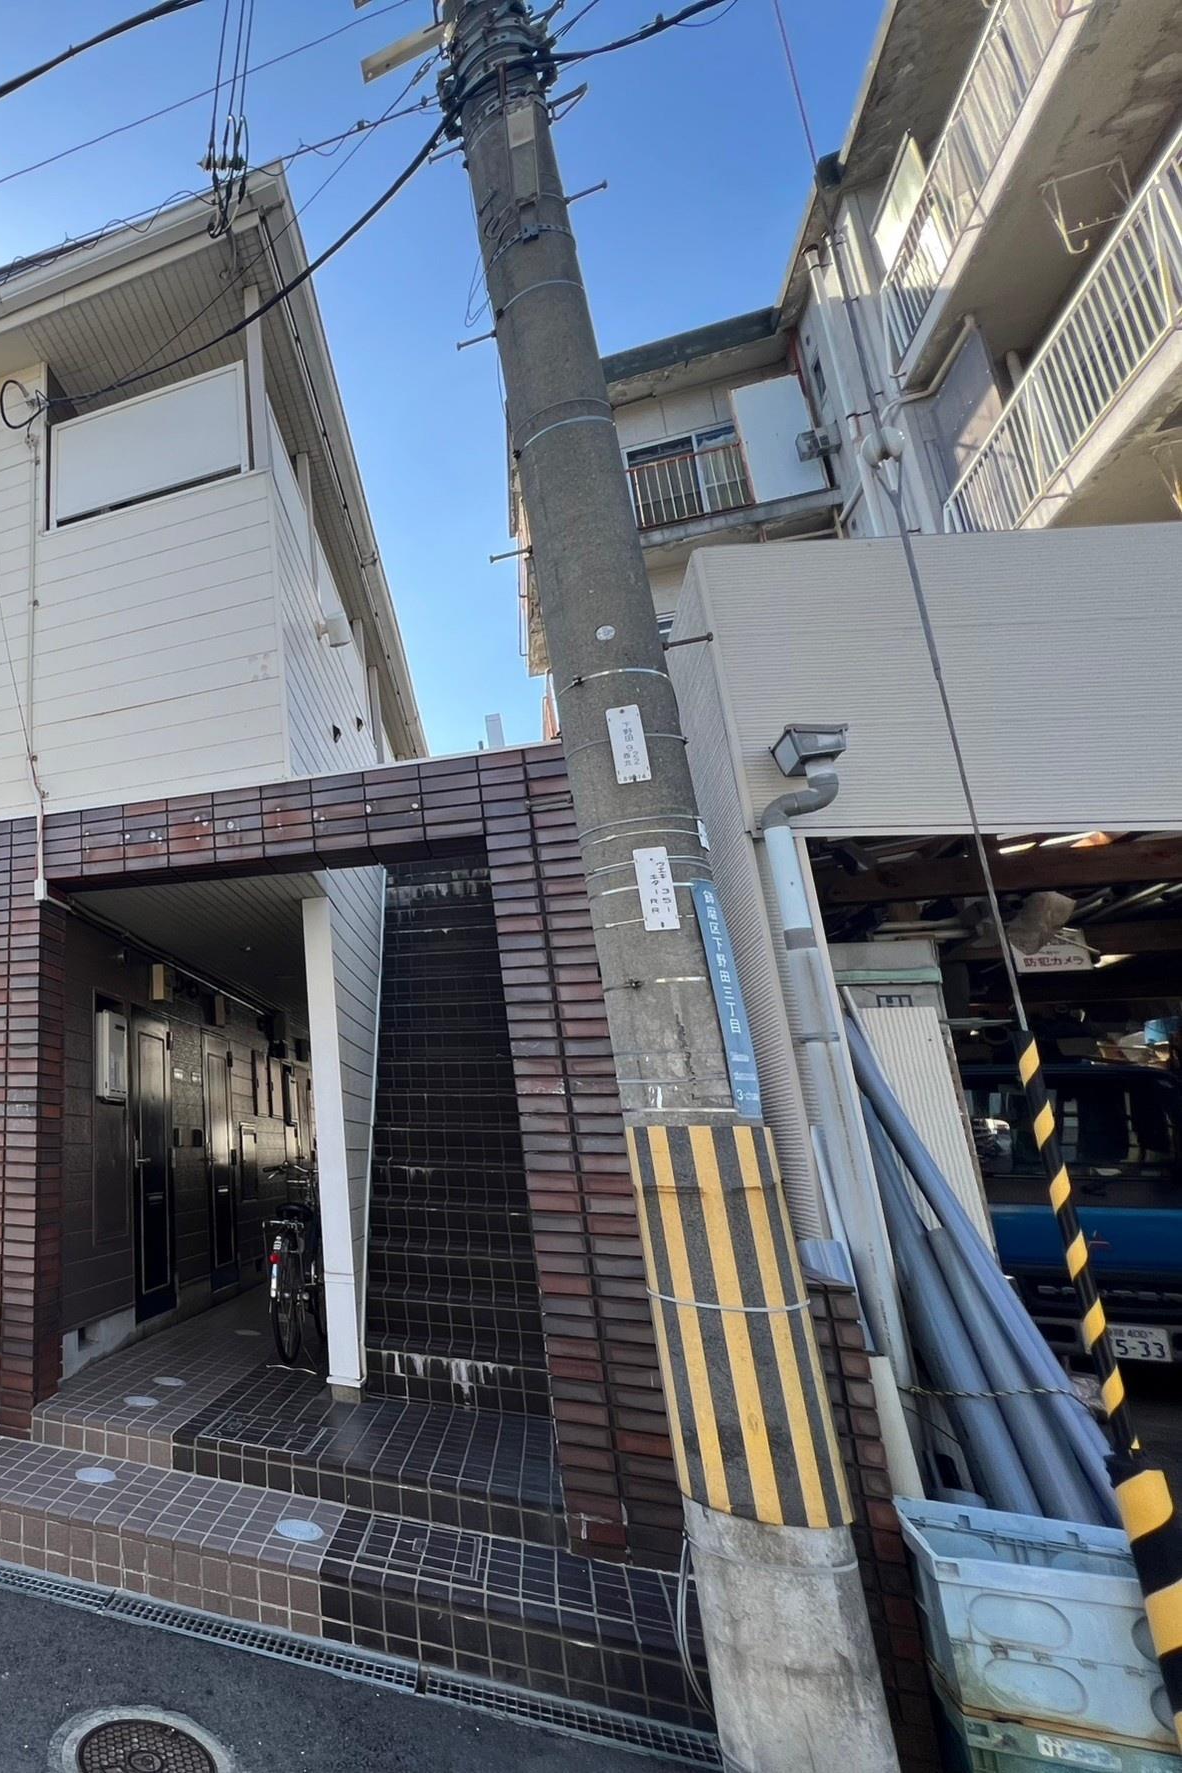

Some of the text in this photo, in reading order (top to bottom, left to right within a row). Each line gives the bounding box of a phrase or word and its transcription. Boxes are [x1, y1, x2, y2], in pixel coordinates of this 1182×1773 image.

[1023, 955, 1085, 968] 防犯カメラ
